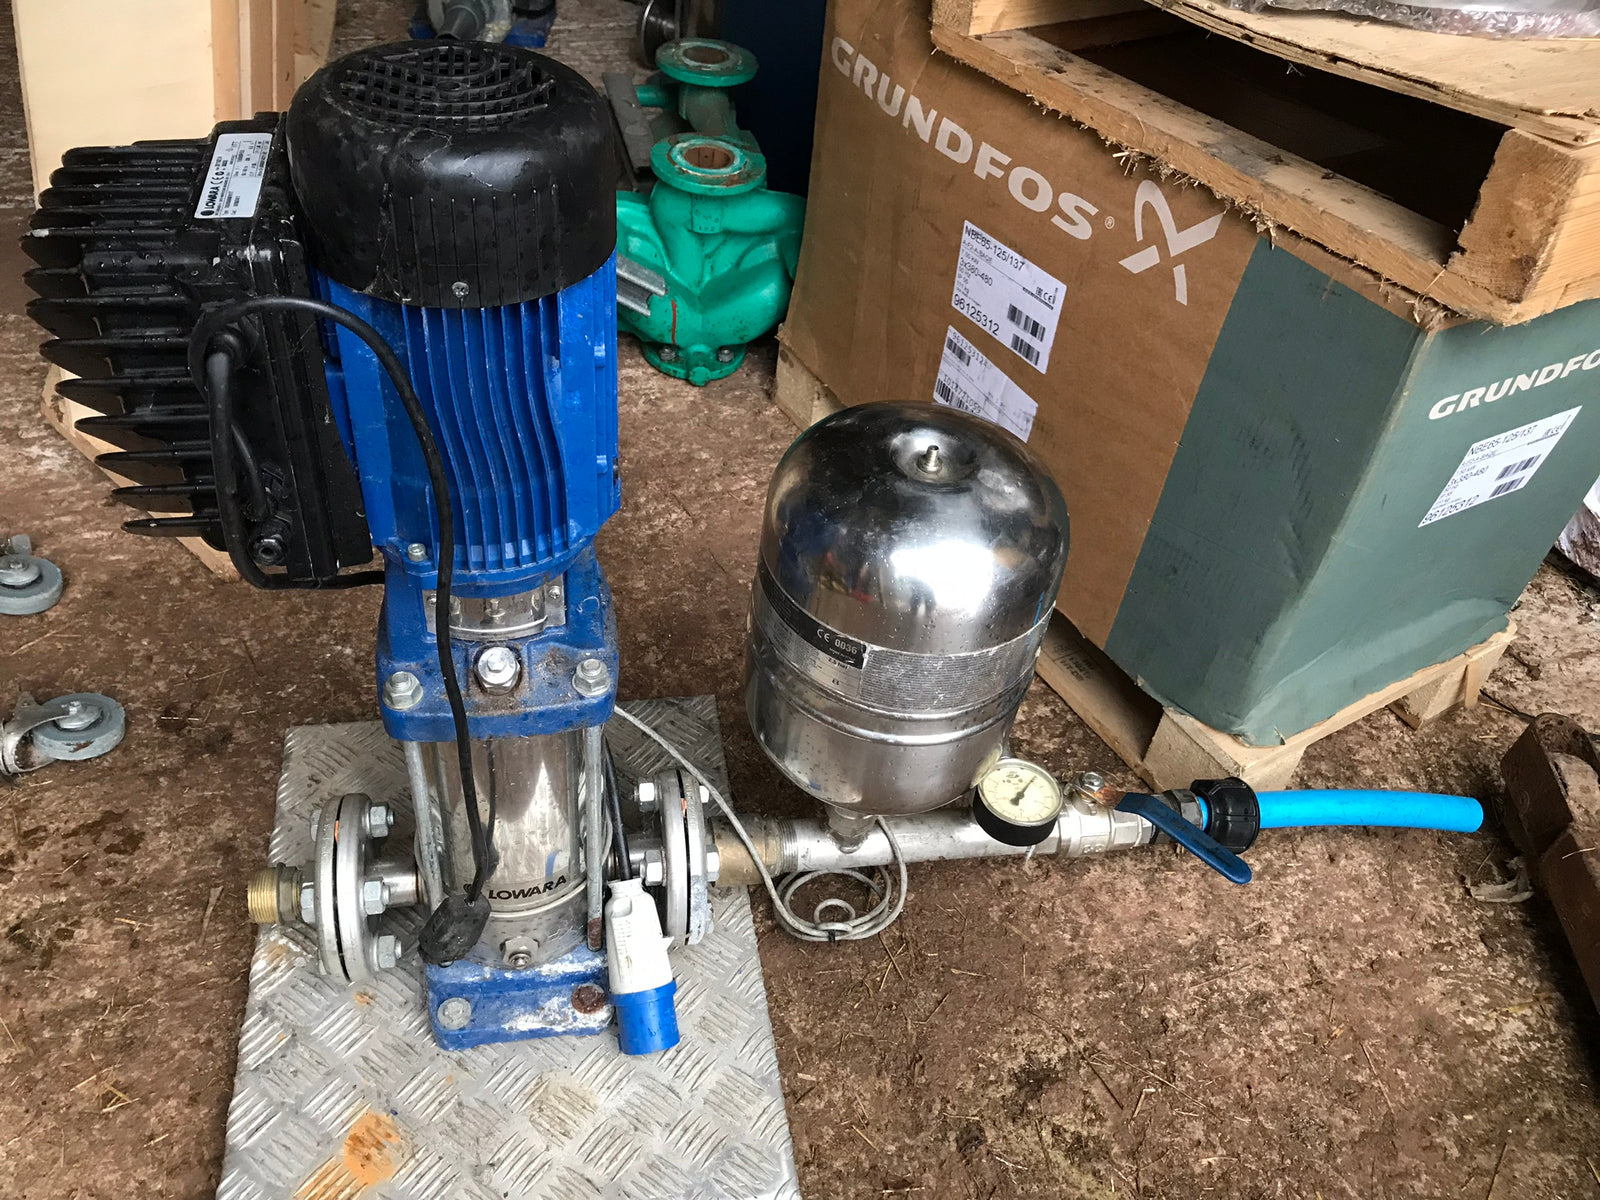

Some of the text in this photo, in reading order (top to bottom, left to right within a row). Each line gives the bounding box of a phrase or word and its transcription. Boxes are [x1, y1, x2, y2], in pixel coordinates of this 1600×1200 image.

[831, 36, 1099, 240] GRUNDFOS
[965, 226, 1025, 271] NBE65-125/137
[953, 294, 1000, 336] 96125312
[834, 639, 858, 654] 0036
[488, 875, 567, 900] LOWARA
